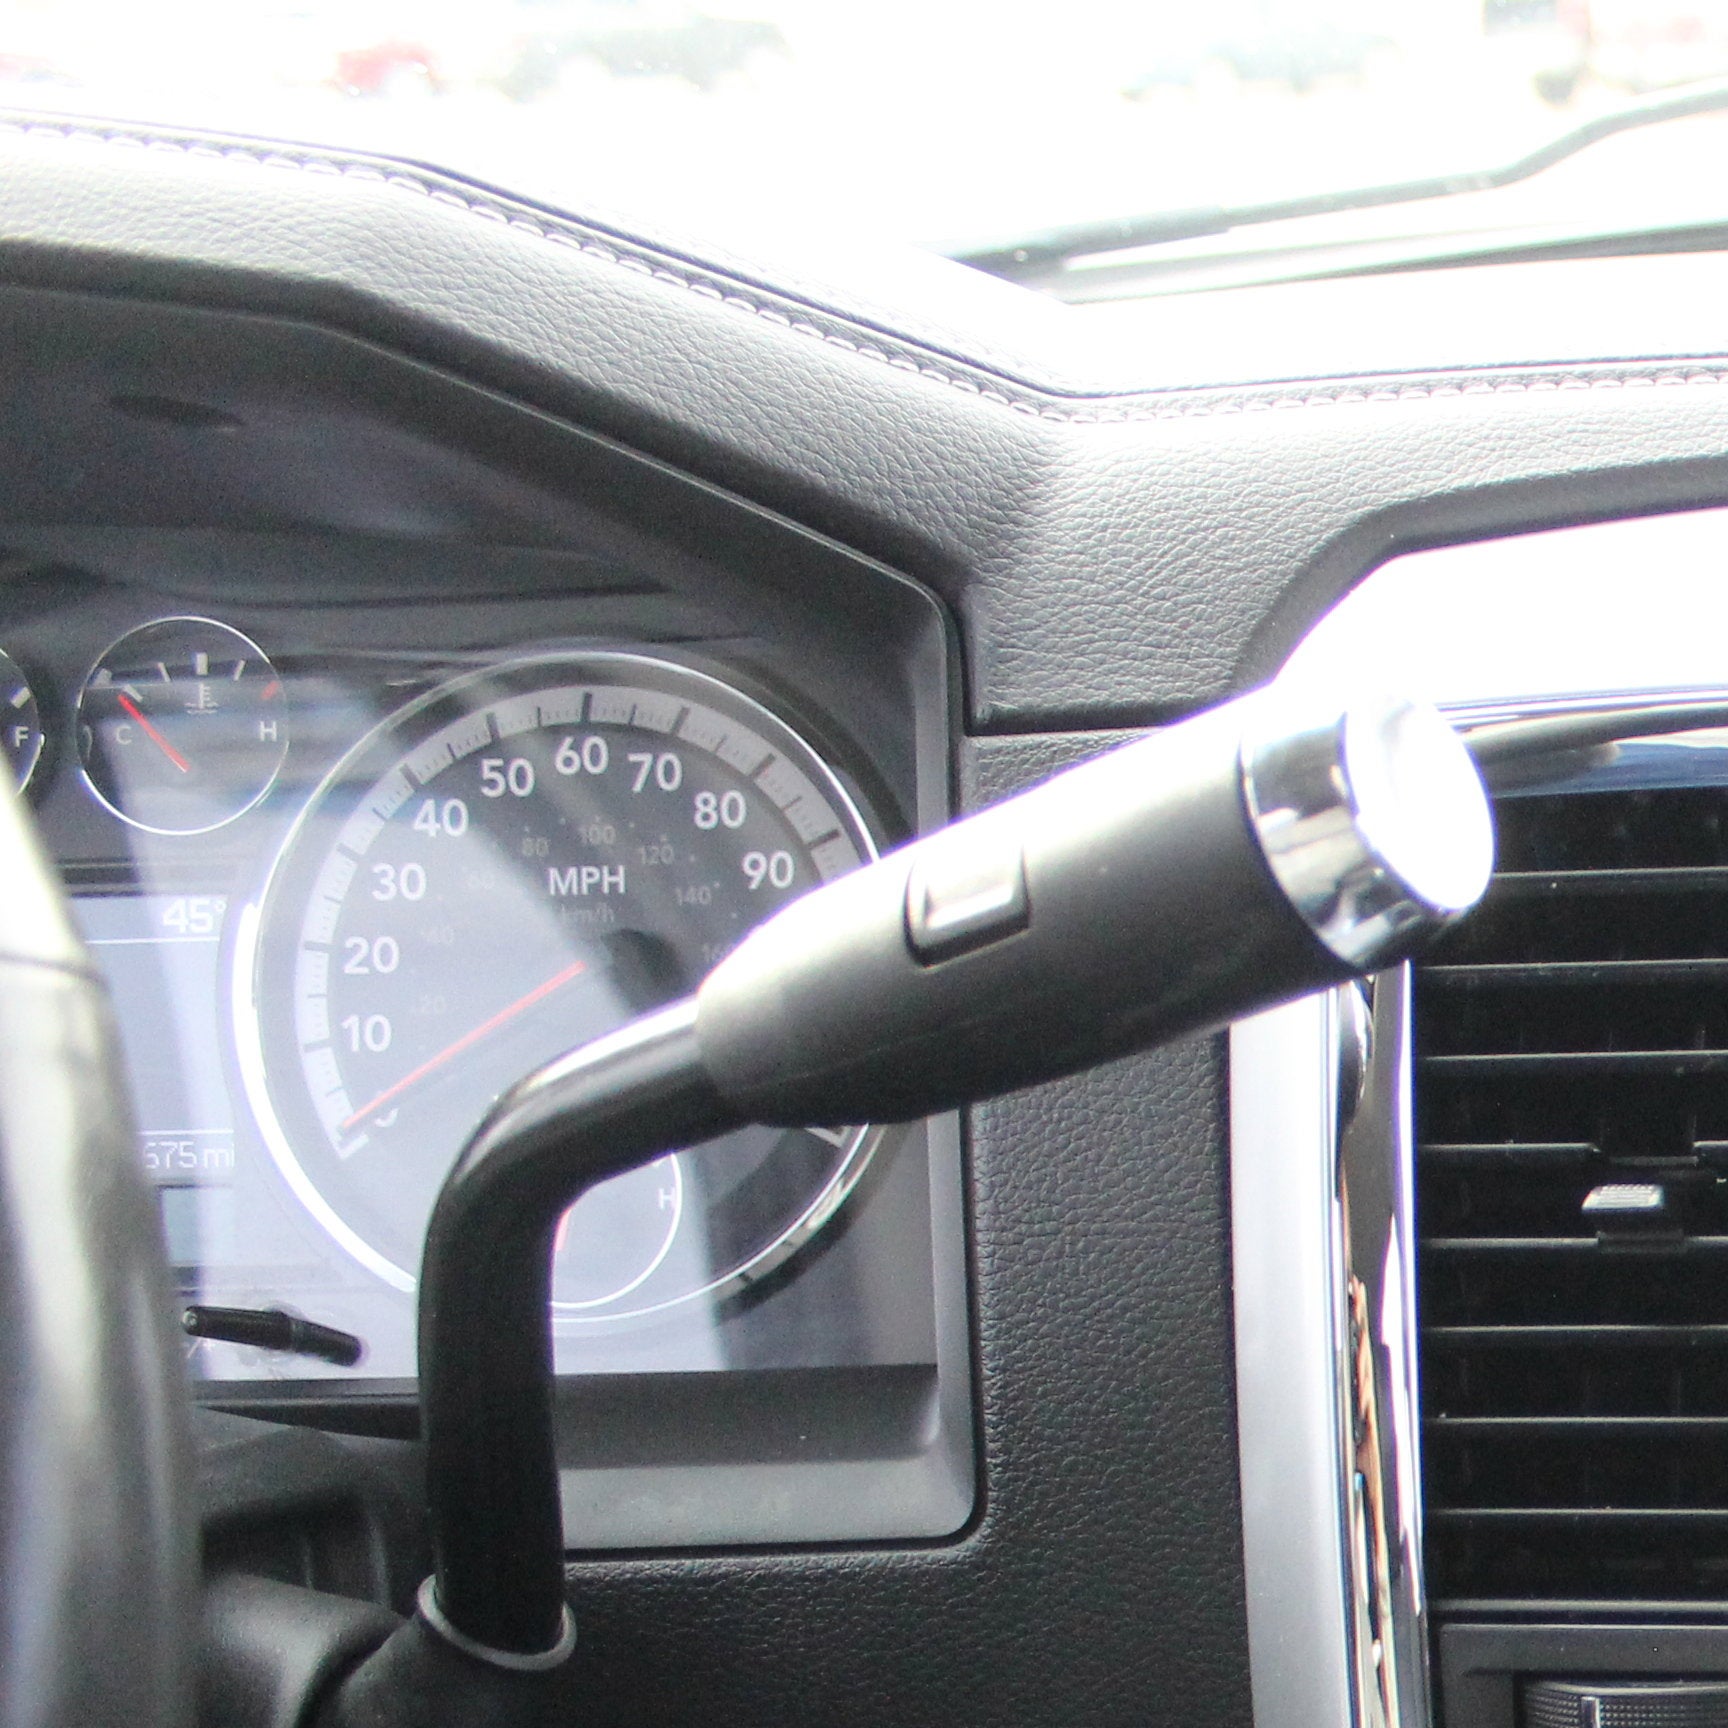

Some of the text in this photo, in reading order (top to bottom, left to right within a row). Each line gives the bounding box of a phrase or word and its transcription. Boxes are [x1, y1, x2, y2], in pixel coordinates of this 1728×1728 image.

[555, 736, 609, 775] 60
[628, 753, 683, 793] 70
[481, 758, 535, 798] 50
[413, 799, 469, 837] 40
[694, 790, 747, 829] 80
[372, 863, 427, 901] 30
[548, 865, 626, 895] MPH
[742, 851, 794, 890] 90
[343, 936, 399, 975] 20
[341, 1014, 392, 1053] 10
